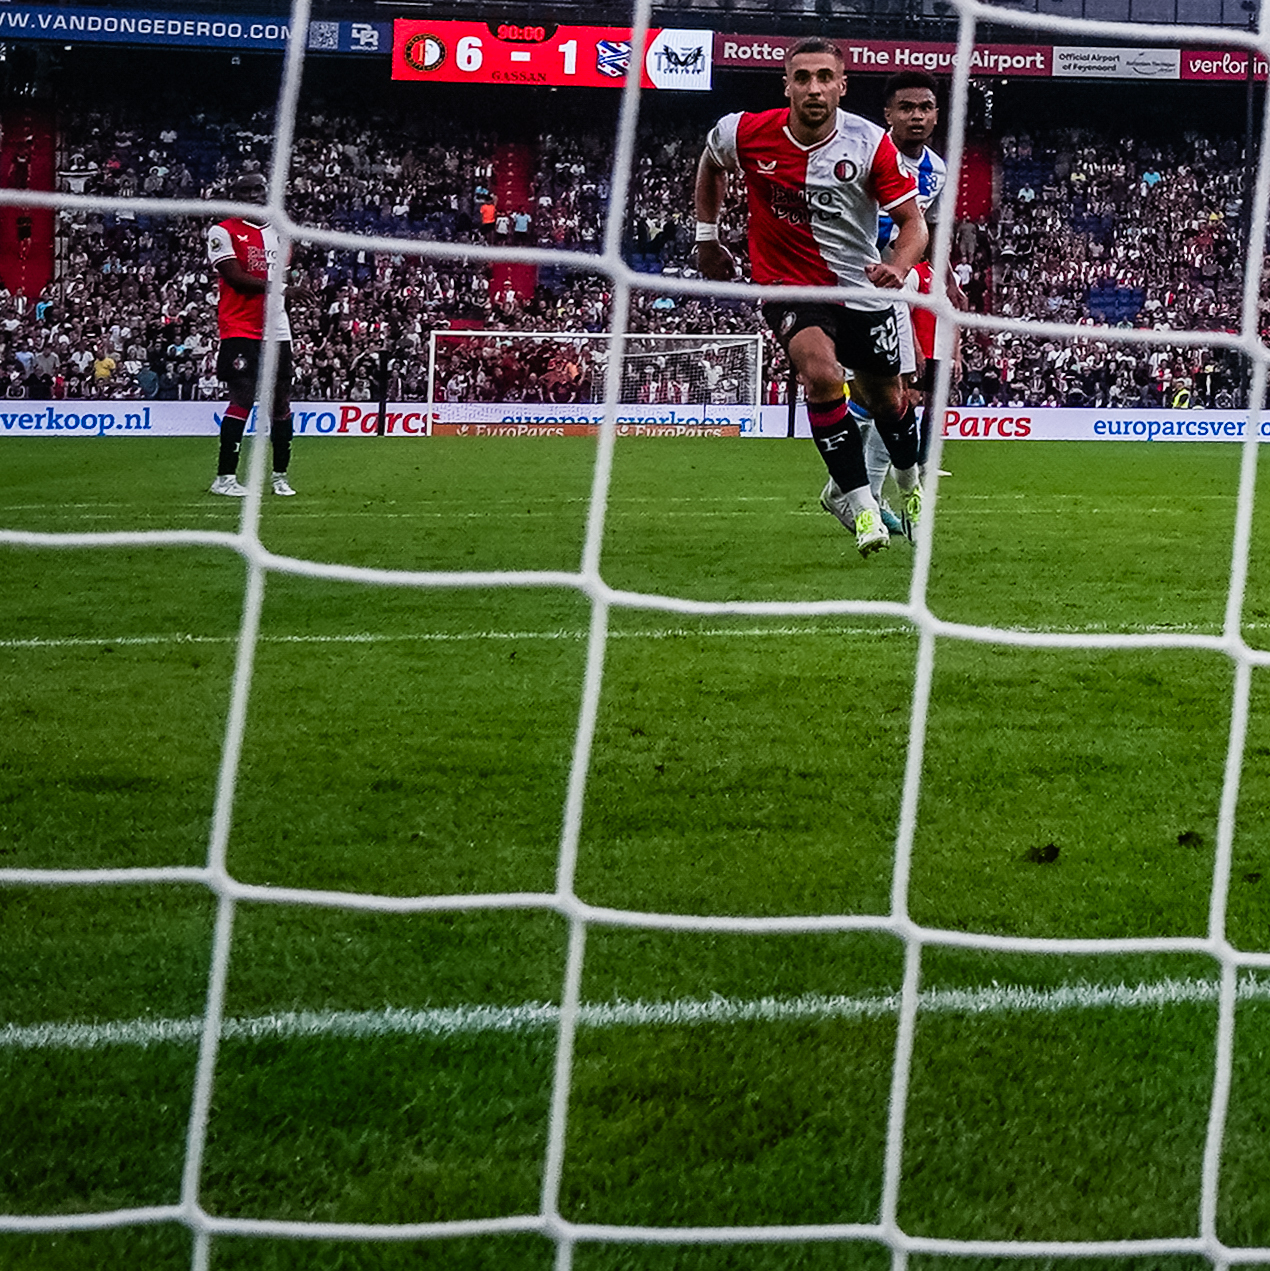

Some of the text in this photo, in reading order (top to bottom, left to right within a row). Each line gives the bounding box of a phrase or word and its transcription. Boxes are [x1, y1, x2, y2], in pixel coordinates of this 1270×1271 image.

[0, 12, 292, 41] W.VANDONGEDEROO.COM
[455, 36, 483, 72] 6
[558, 40, 578, 75] 1
[723, 42, 786, 61] Rotte
[849, 46, 889, 65] The
[970, 50, 1045, 72] Airport
[1059, 53, 1120, 63] Official Airport
[491, 70, 547, 81] GASSAN
[1073, 64, 1117, 73] Feyenoord
[771, 184, 832, 207] Euro
[942, 410, 1032, 437] Parcs
